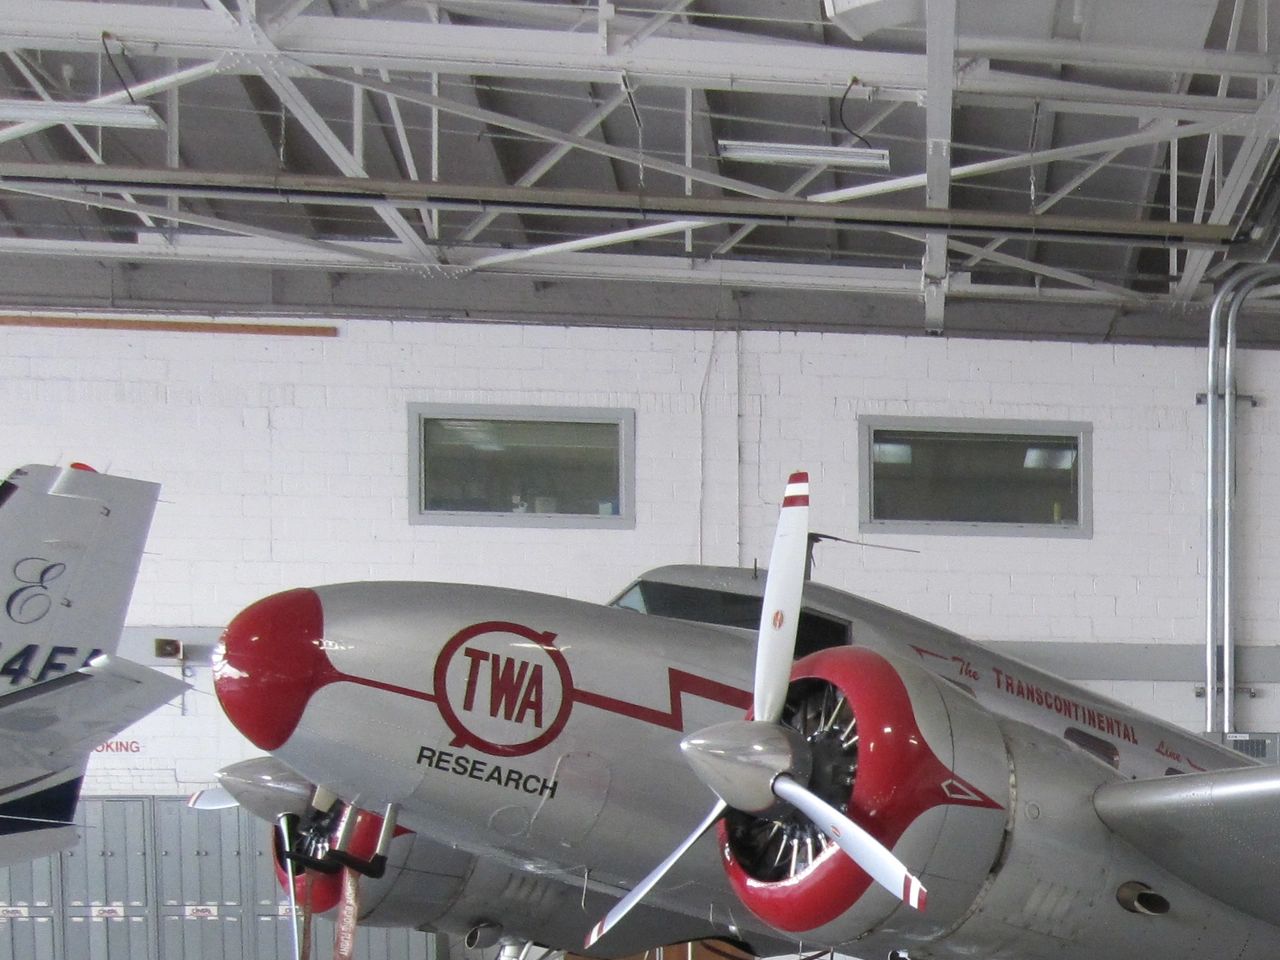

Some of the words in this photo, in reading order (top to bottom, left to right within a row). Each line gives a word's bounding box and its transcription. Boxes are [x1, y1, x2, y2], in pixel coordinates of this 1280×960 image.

[463, 646, 543, 729] TWA
[951, 655, 980, 681] The
[992, 667, 1139, 745] TRANSCONTINENTAL
[1154, 740, 1182, 763] Line
[416, 746, 559, 799] RESEARCH
